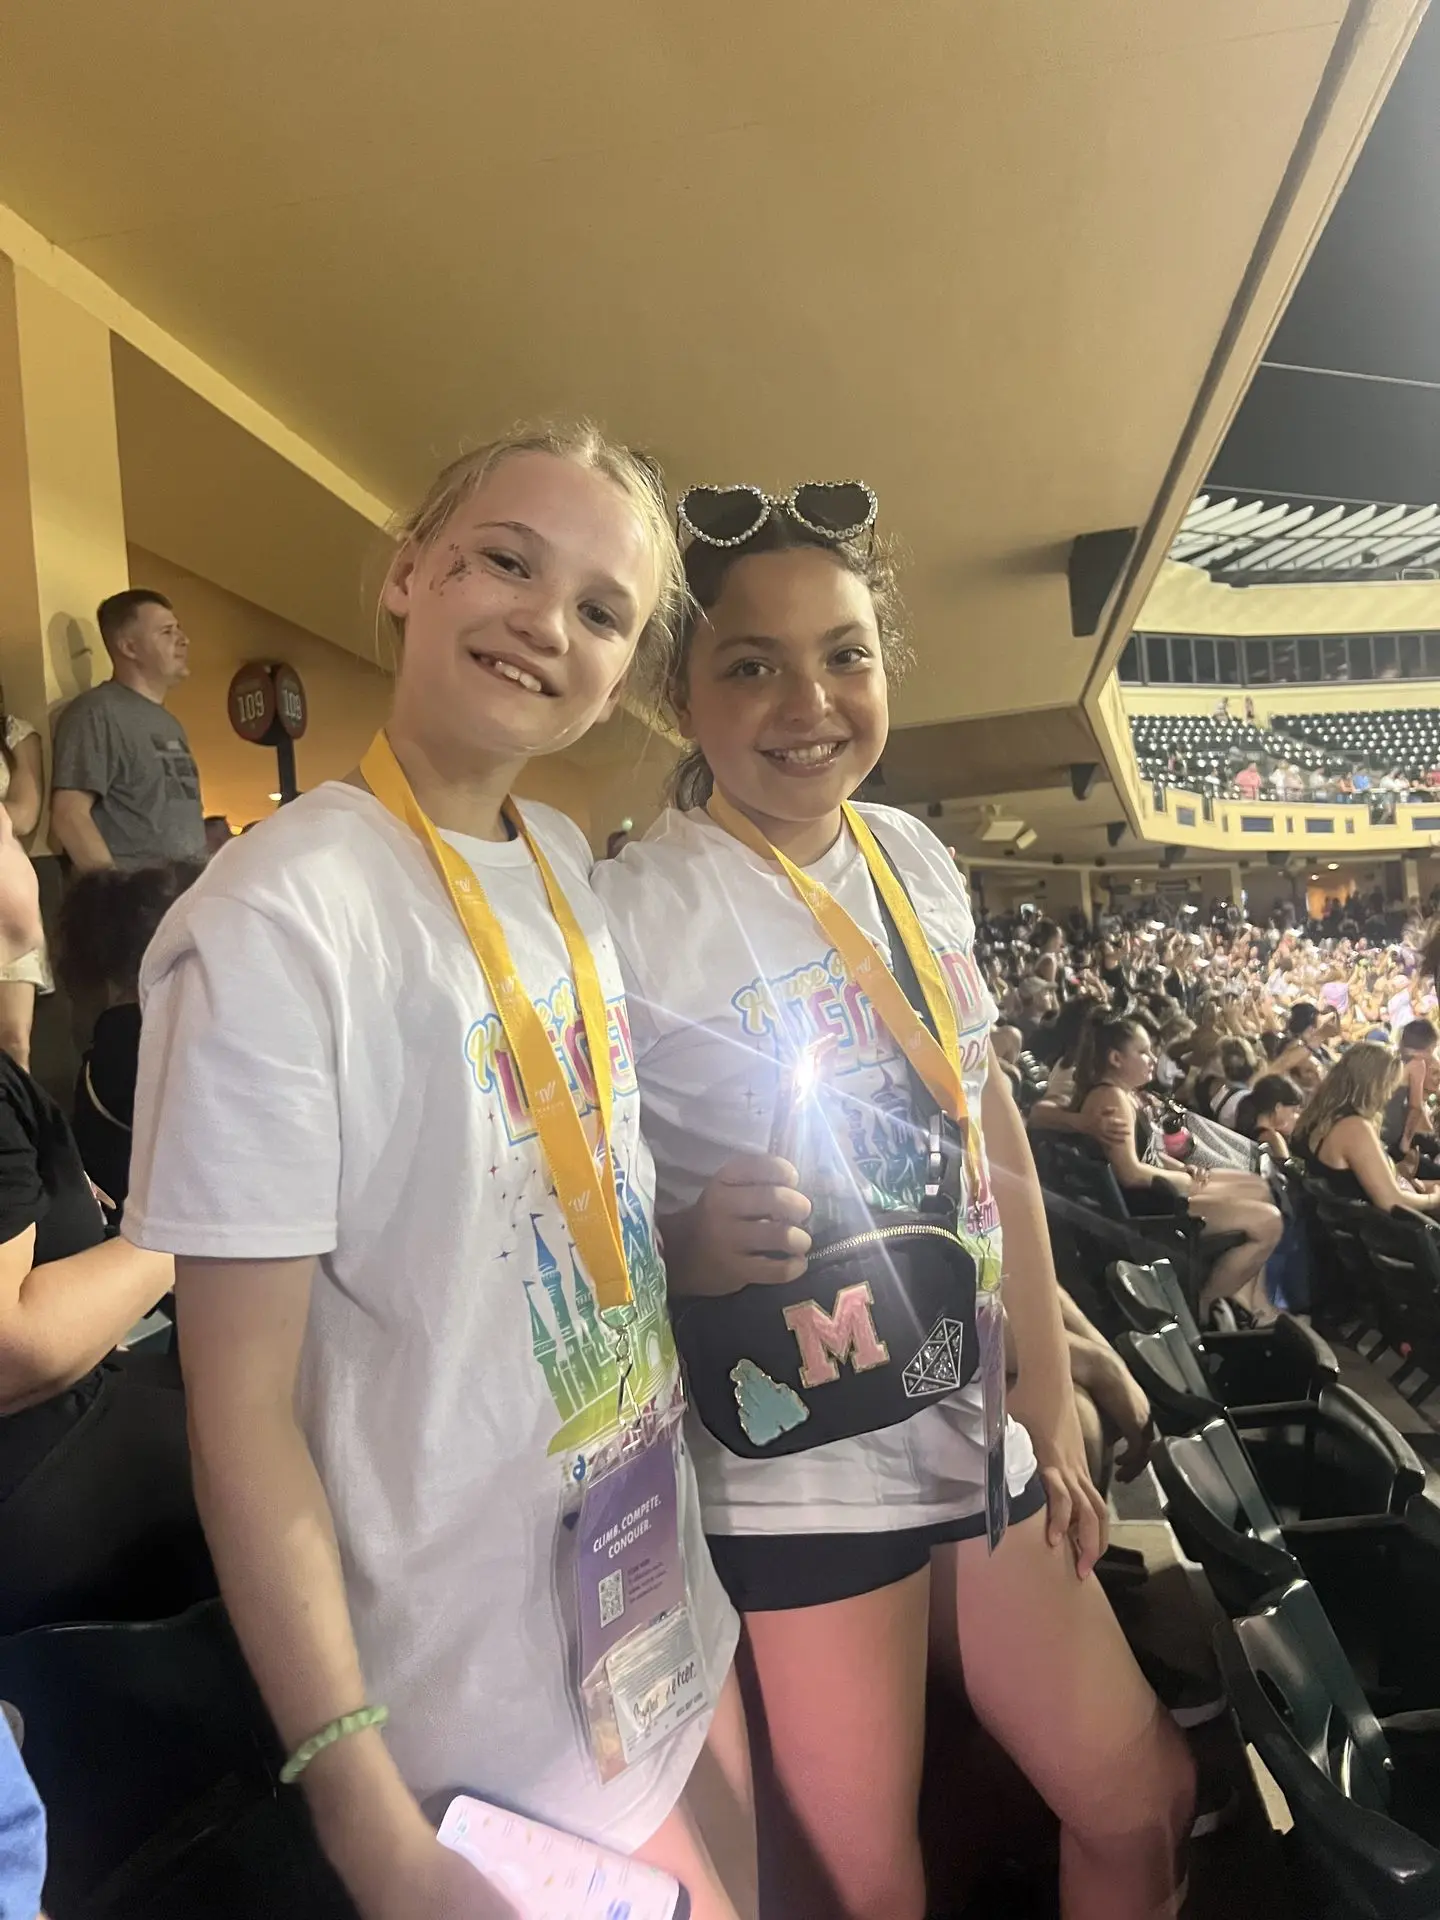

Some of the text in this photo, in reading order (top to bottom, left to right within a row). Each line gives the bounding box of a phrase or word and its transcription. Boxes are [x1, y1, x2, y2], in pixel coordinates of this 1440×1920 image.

[238, 690, 265, 723] 109
[782, 1281, 891, 1389] M
[593, 1494, 662, 1553] CLIMB. COMPETE.
[608, 1519, 652, 1559] CONQUER.
